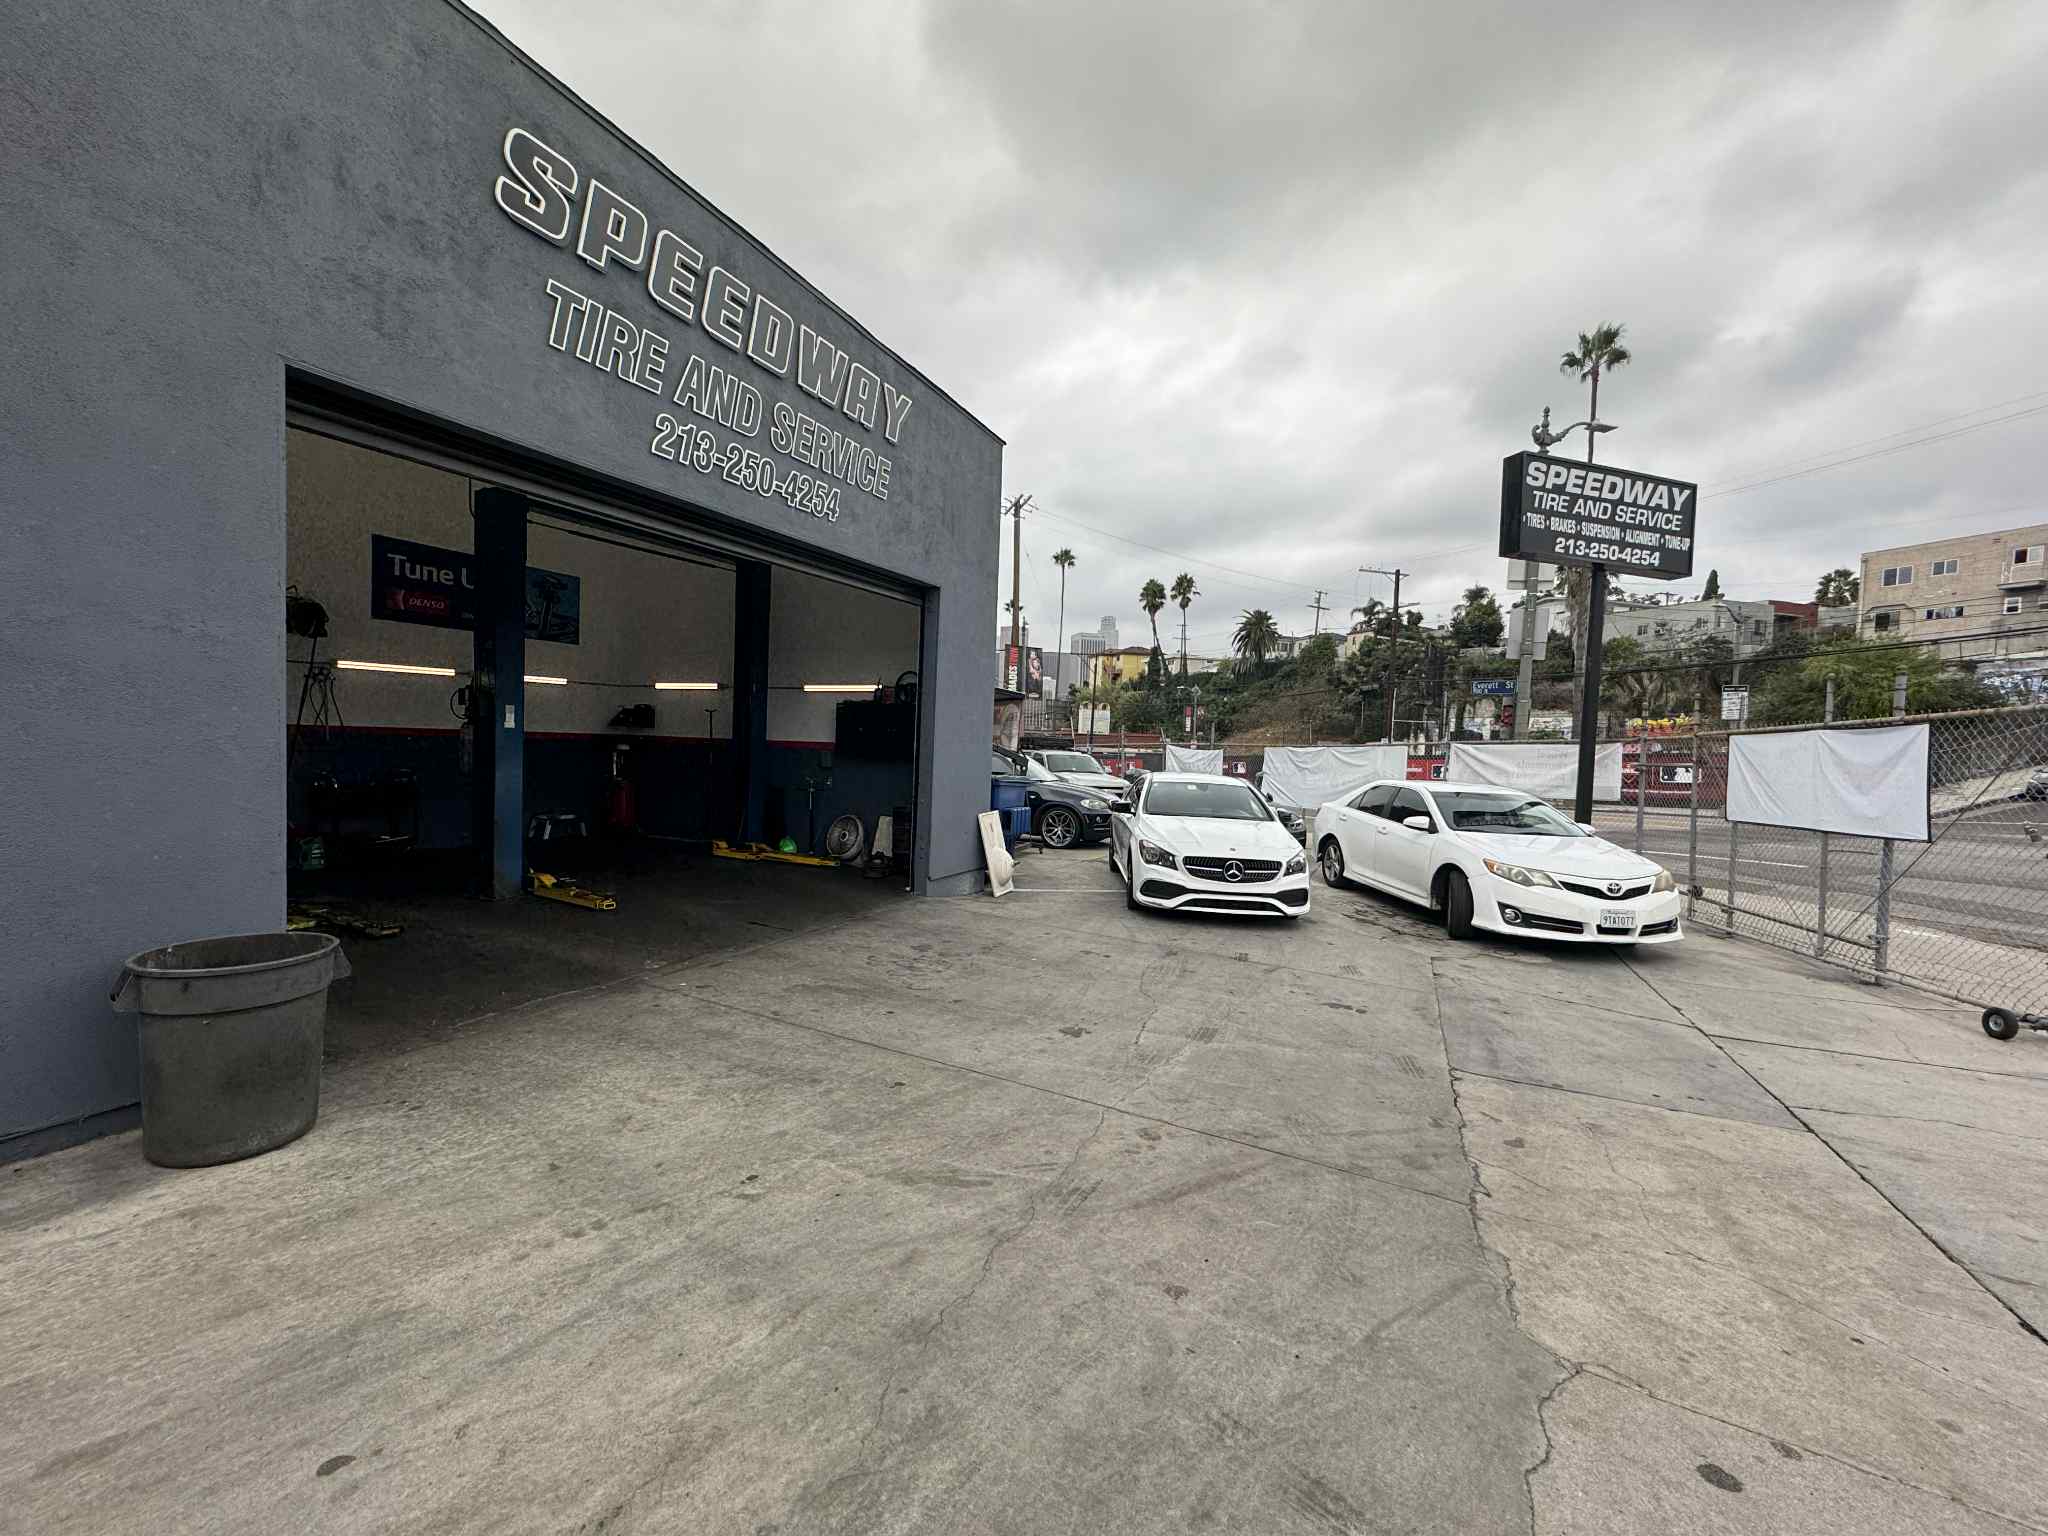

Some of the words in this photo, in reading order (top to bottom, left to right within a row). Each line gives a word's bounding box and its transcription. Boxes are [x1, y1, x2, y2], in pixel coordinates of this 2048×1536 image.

[494, 127, 913, 446] SPEEDWAY
[546, 278, 670, 395] TIRE
[674, 355, 763, 438] AND
[770, 402, 892, 500] SERVICE
[651, 413, 841, 522] 213-250-4254
[1526, 461, 1691, 511] SPEEDWAY
[1526, 512, 1545, 529] TIRES
[1550, 517, 1576, 534] BRAKES
[1581, 522, 1621, 541] SUSPENSION
[1625, 529, 1661, 547] ALIGNMENT
[1533, 490, 1570, 512] TIRE
[1572, 499, 1611, 520] AND
[1615, 505, 1682, 531] SERVICE
[387, 553, 455, 585] Tune
[1555, 537, 1660, 566] 213-250-4254
[408, 597, 445, 609] DENSO
[1472, 681, 1499, 689] Everett
[1505, 681, 1514, 689] St
